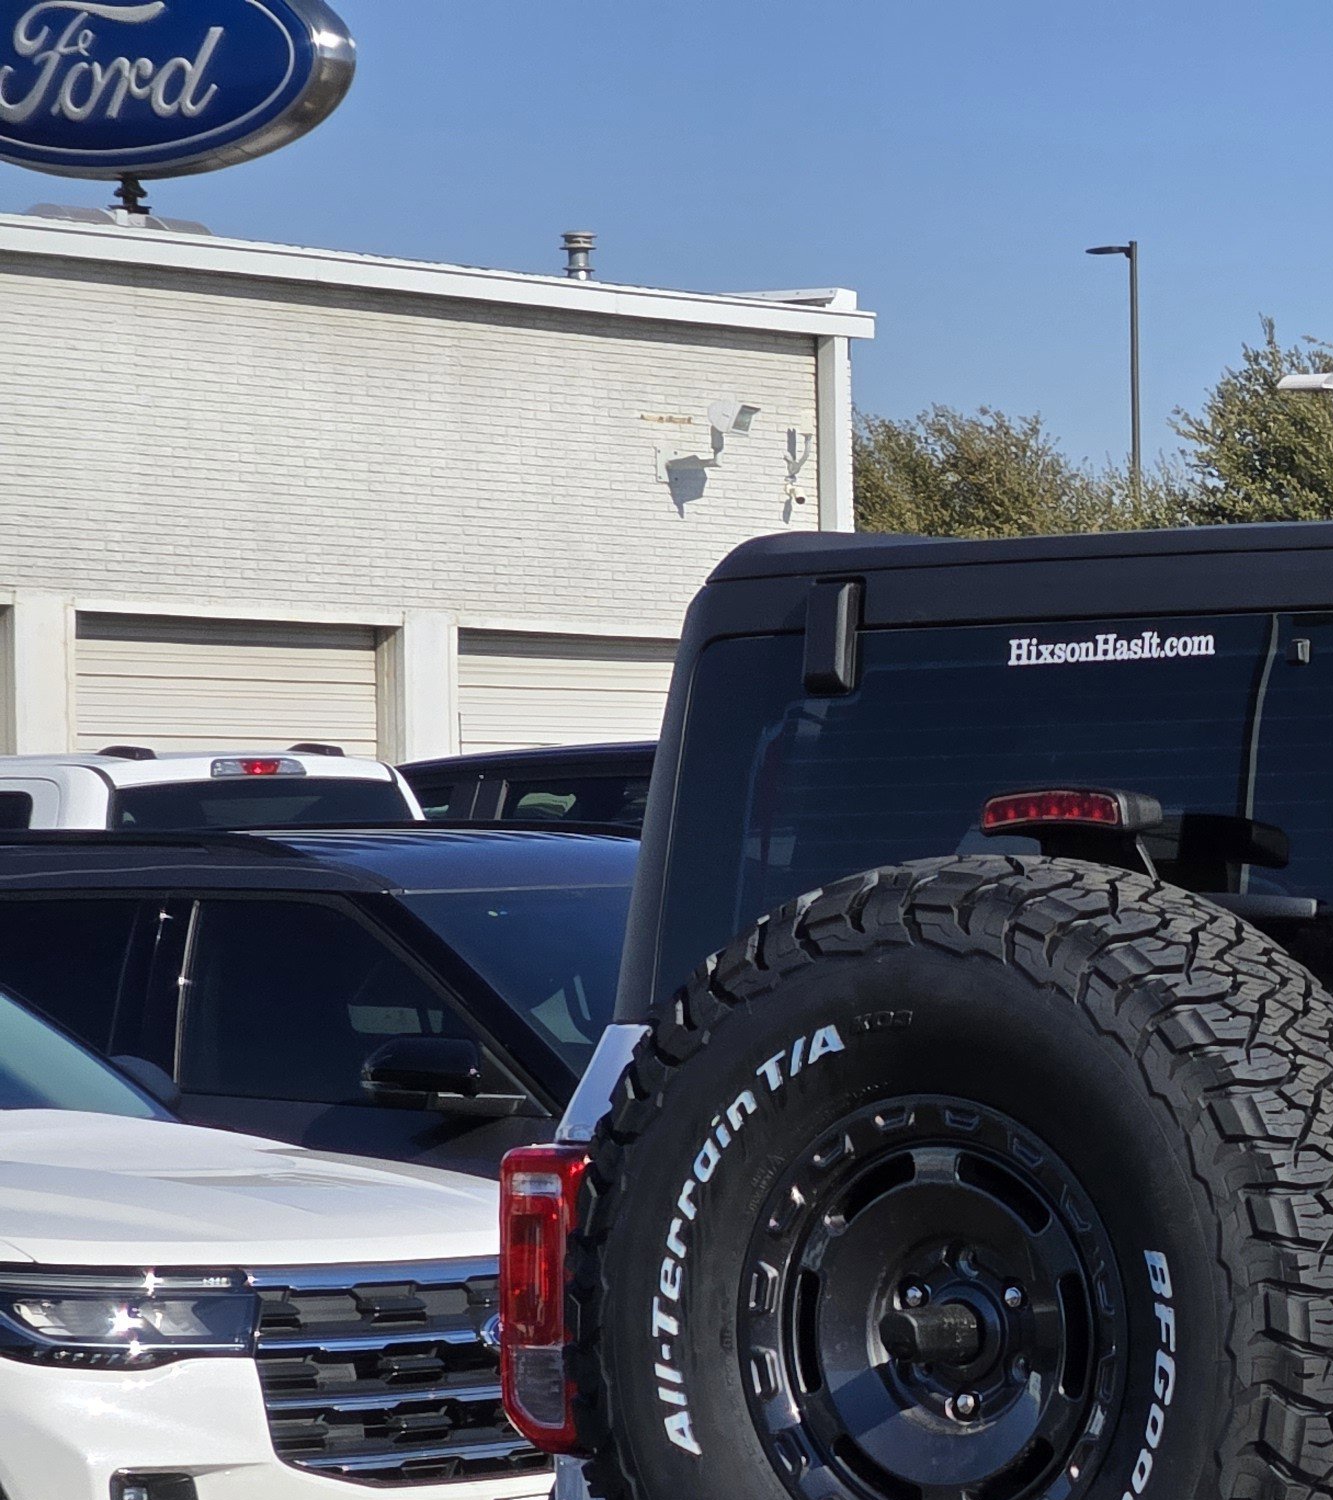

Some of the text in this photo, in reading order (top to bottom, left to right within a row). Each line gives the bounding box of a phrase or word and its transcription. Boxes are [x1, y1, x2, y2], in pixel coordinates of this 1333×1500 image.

[0, 0, 224, 122] Ford
[1008, 631, 1215, 666] HixsonHasIt.com
[651, 1089, 758, 1456] All-Terrain
[756, 1023, 846, 1092] T/A
